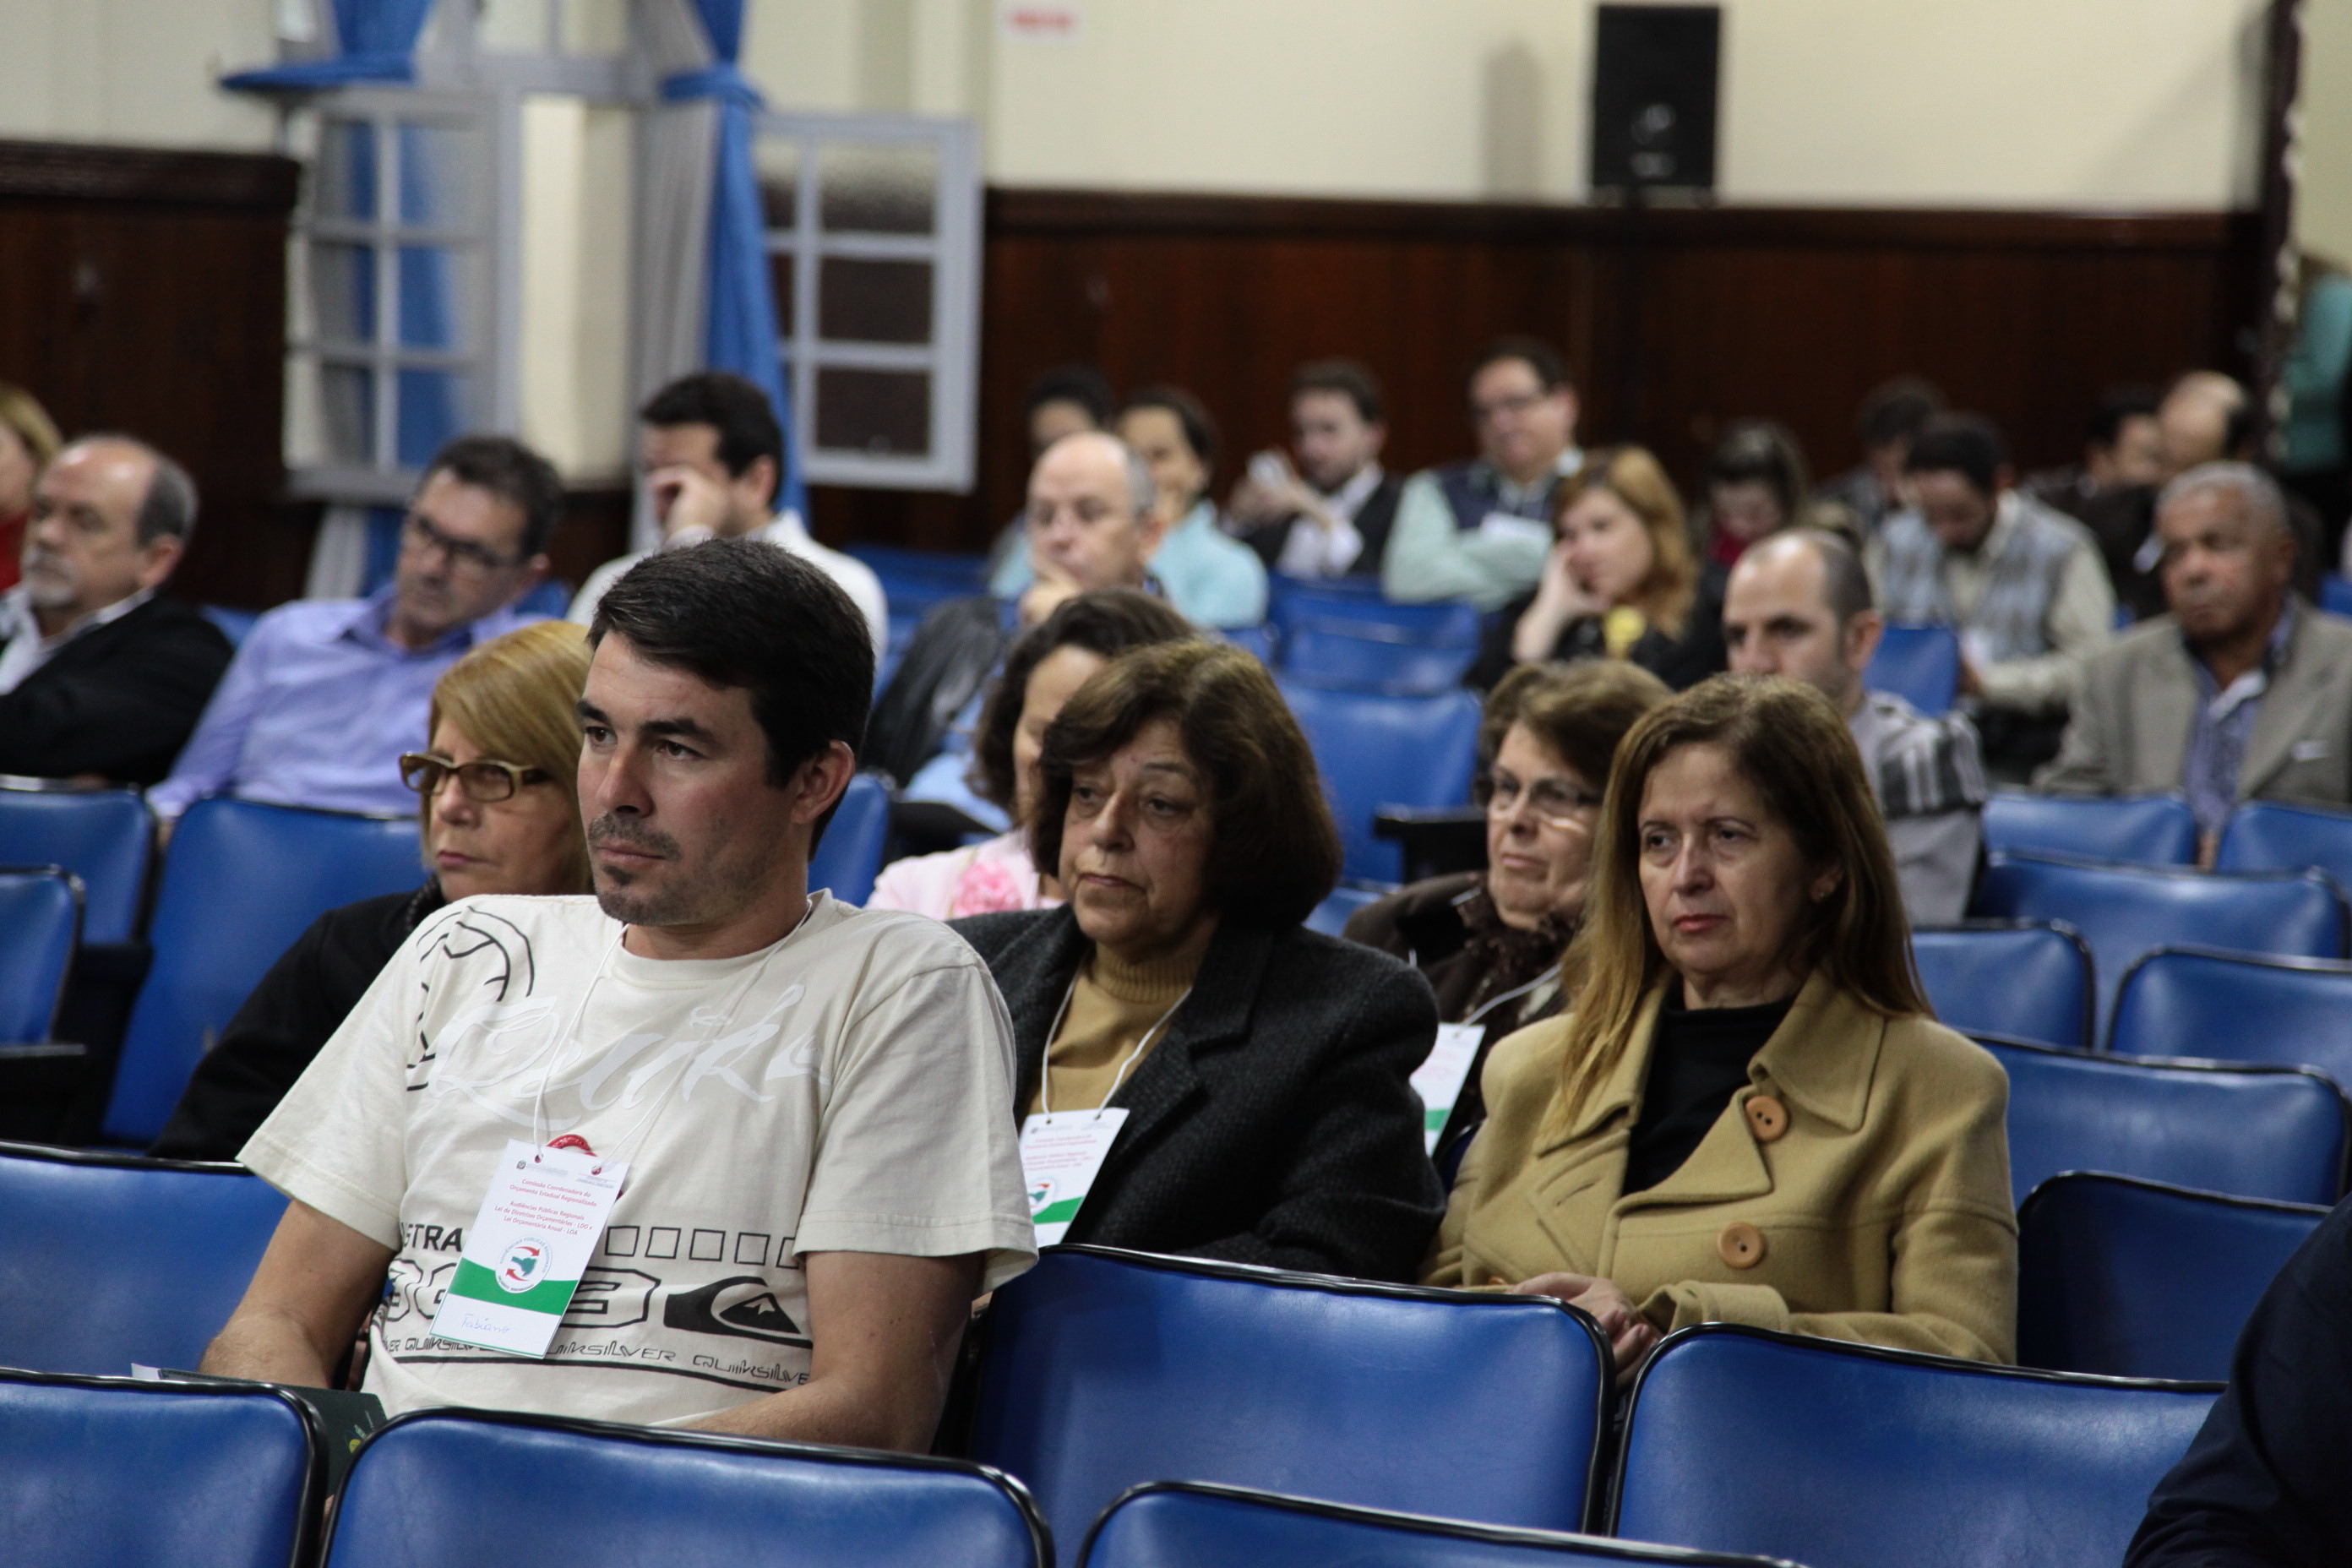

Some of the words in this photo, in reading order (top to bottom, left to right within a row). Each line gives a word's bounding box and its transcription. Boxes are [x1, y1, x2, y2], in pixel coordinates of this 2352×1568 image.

[509, 1184, 538, 1195] Orçamento
[538, 1190, 560, 1200] Estadual
[560, 1195, 597, 1207] Regionalizado
[521, 1179, 547, 1189] Comissão
[547, 1184, 583, 1196] Coordenadora
[509, 1200, 537, 1211] Audiências
[538, 1206, 558, 1215] Públicas
[558, 1211, 585, 1221] Regionais
[511, 1209, 536, 1219] Diretrizes
[536, 1214, 574, 1227] Orçamentárias
[512, 1217, 547, 1229] Orçamentária
[693, 1354, 810, 1386] QUIKSILVE
